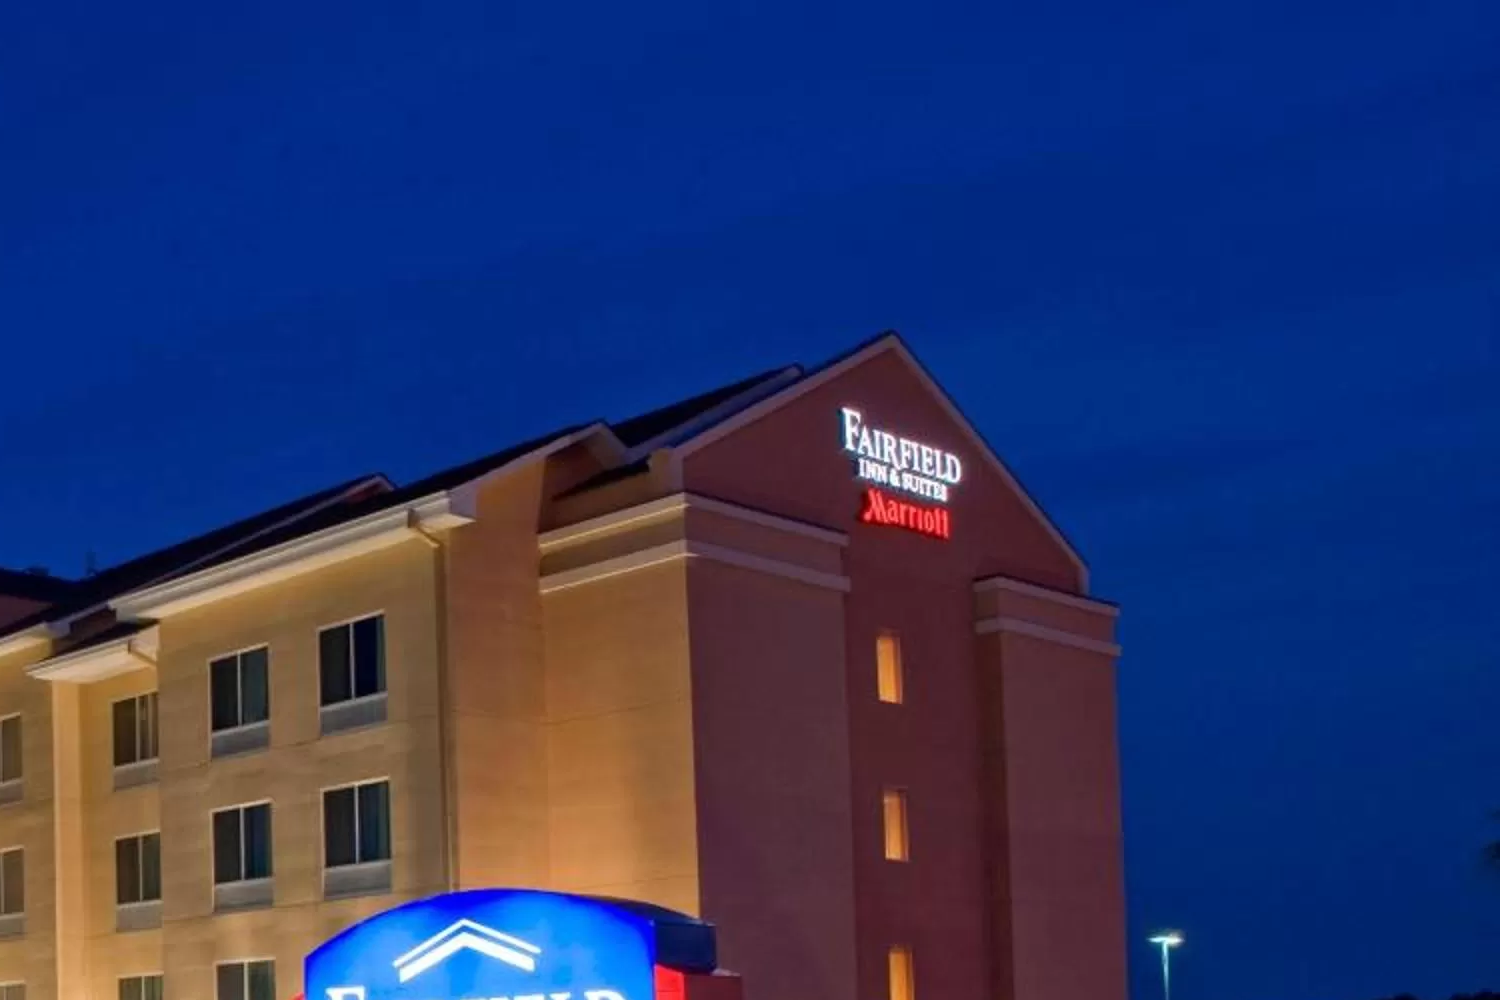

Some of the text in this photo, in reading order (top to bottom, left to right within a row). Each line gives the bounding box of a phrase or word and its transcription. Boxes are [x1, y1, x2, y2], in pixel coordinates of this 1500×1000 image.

[841, 407, 962, 484] FAIRFIELD
[858, 458, 948, 502] INN & SUITES
[863, 488, 949, 538] Marriott
